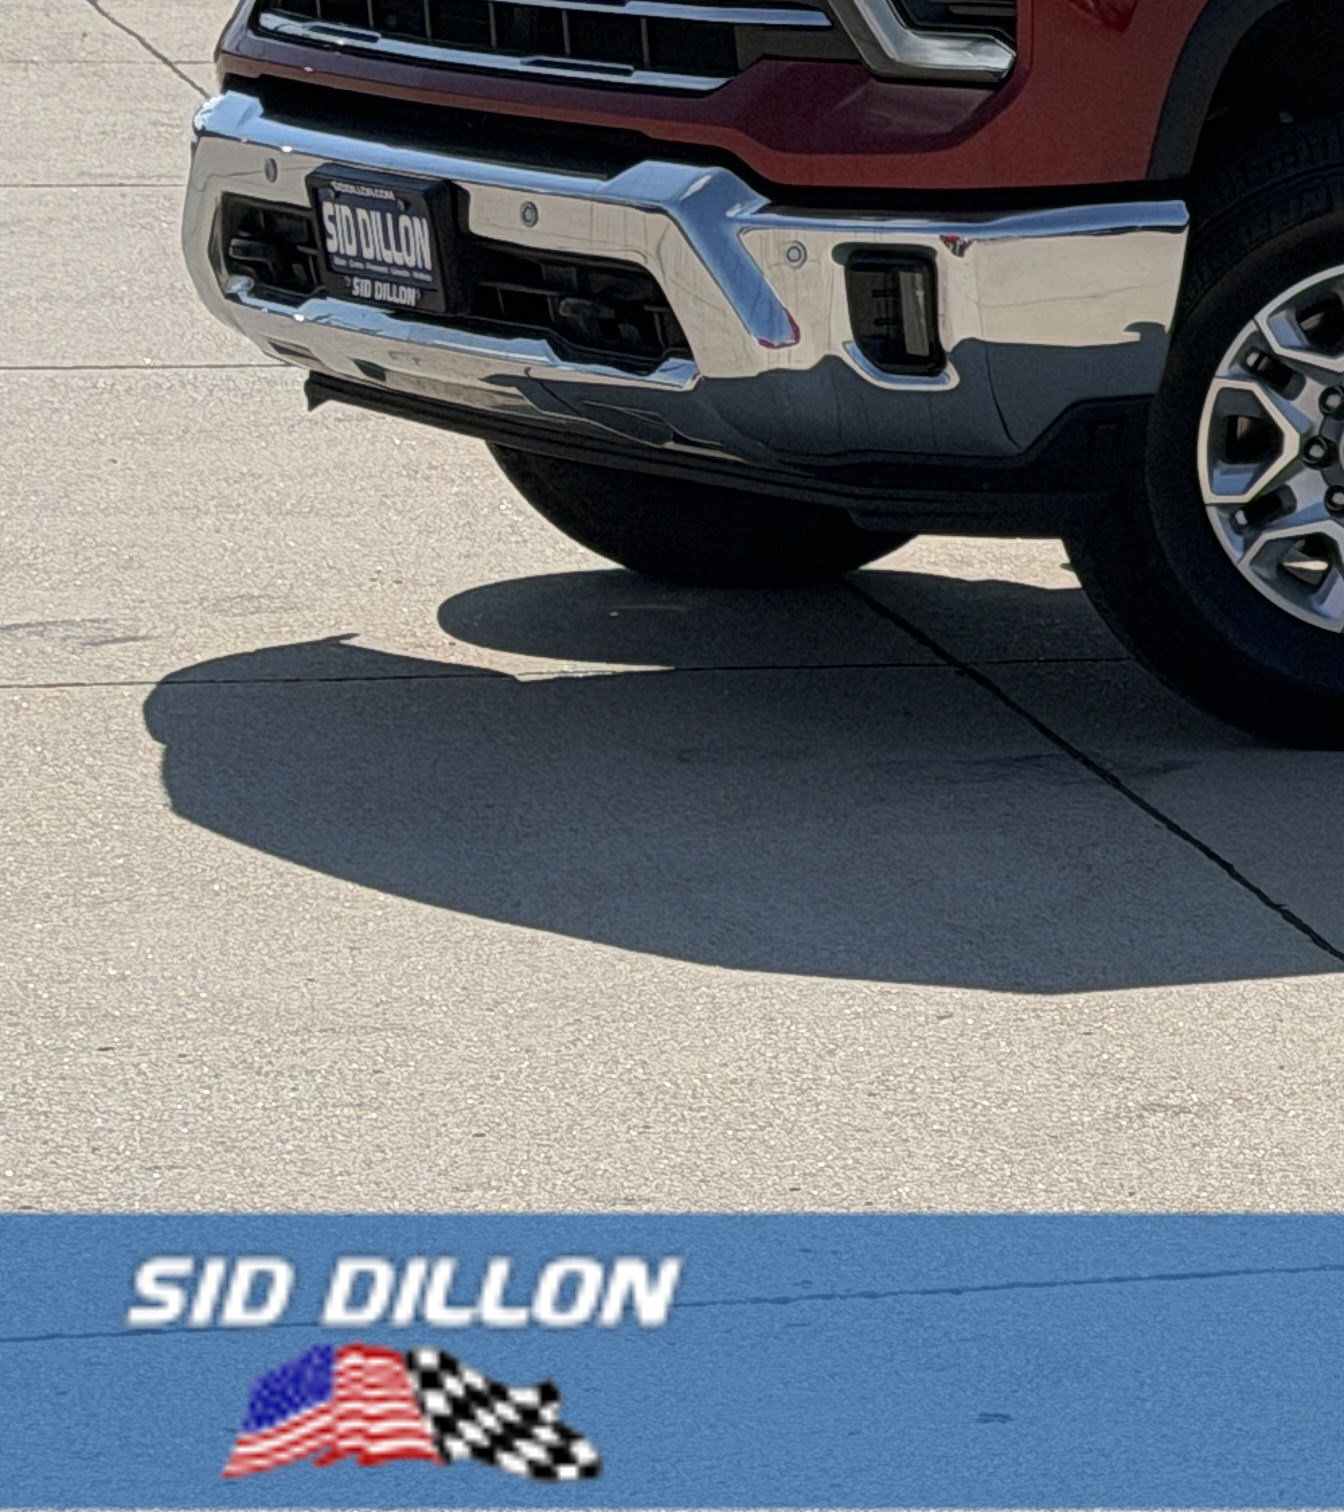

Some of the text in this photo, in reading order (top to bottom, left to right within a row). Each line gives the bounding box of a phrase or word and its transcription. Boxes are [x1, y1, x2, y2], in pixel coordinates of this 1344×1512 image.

[322, 201, 357, 257] SID
[355, 207, 433, 271] DILLON
[351, 276, 416, 307] SID DILLON
